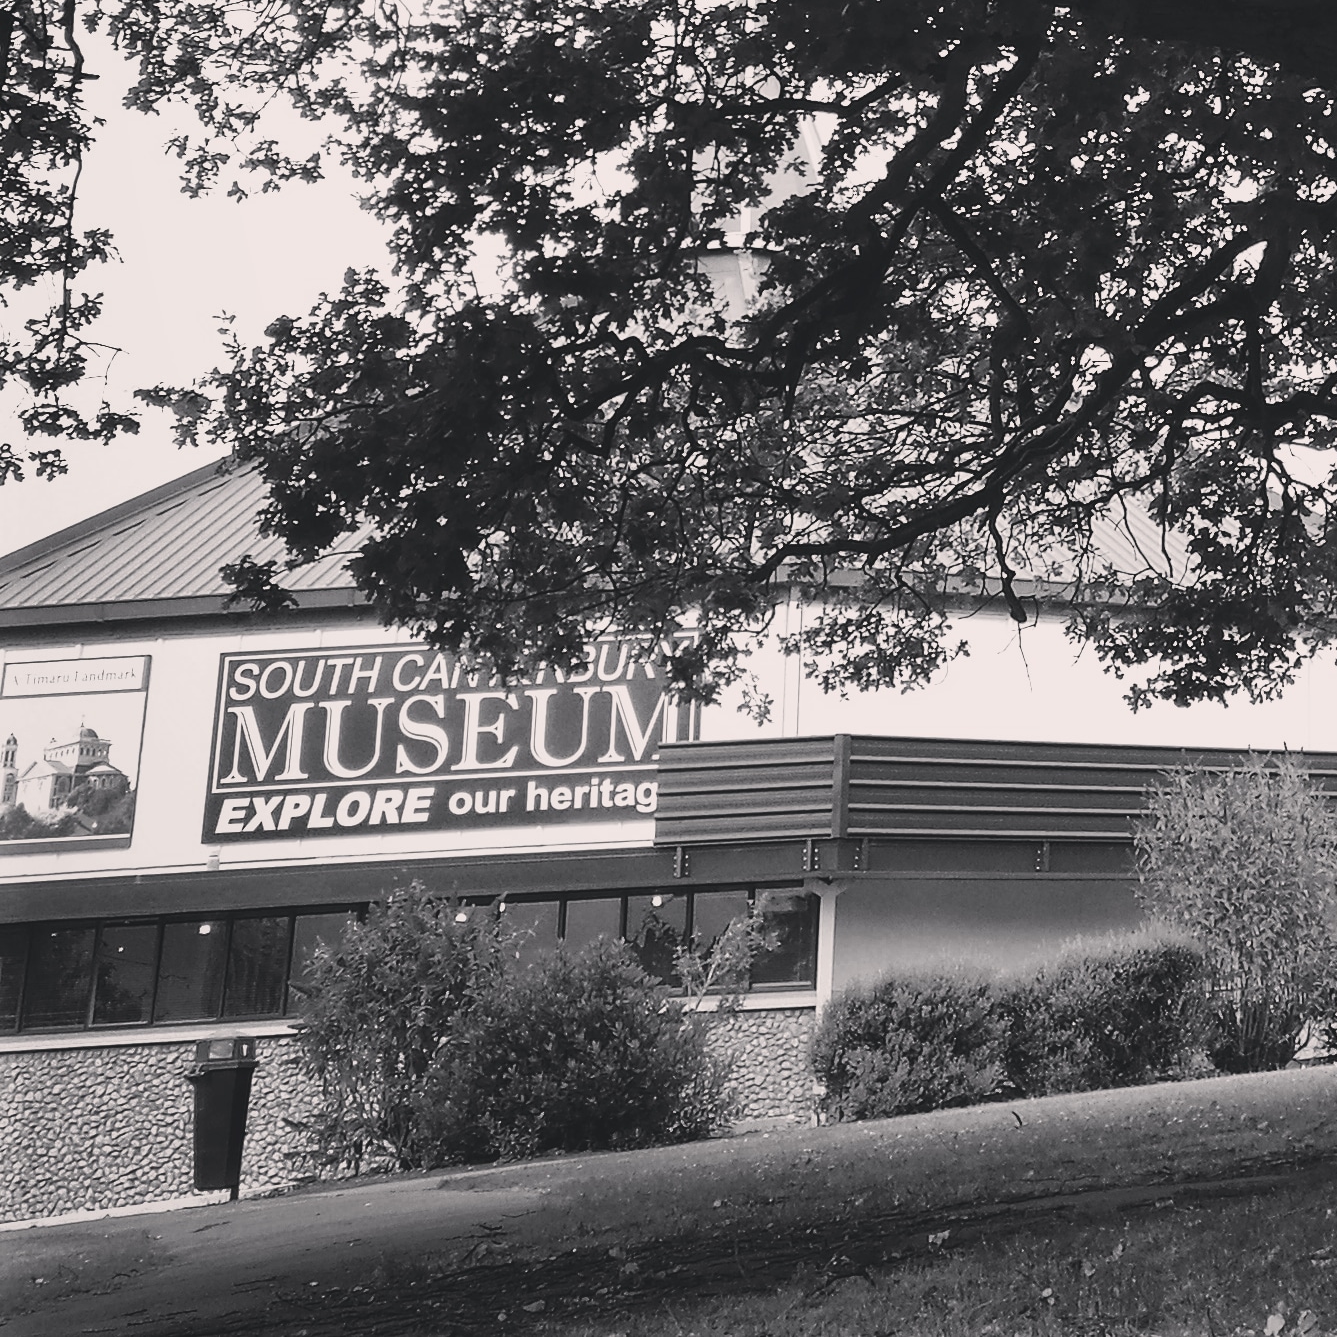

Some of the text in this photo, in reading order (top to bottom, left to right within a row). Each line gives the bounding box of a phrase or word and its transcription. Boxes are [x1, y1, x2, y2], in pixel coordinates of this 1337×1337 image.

[26, 673, 70, 685] Timaru
[228, 656, 383, 701] SOUTH
[220, 684, 678, 784] MUSEUM
[215, 777, 659, 834] EXPLORE our heritag
